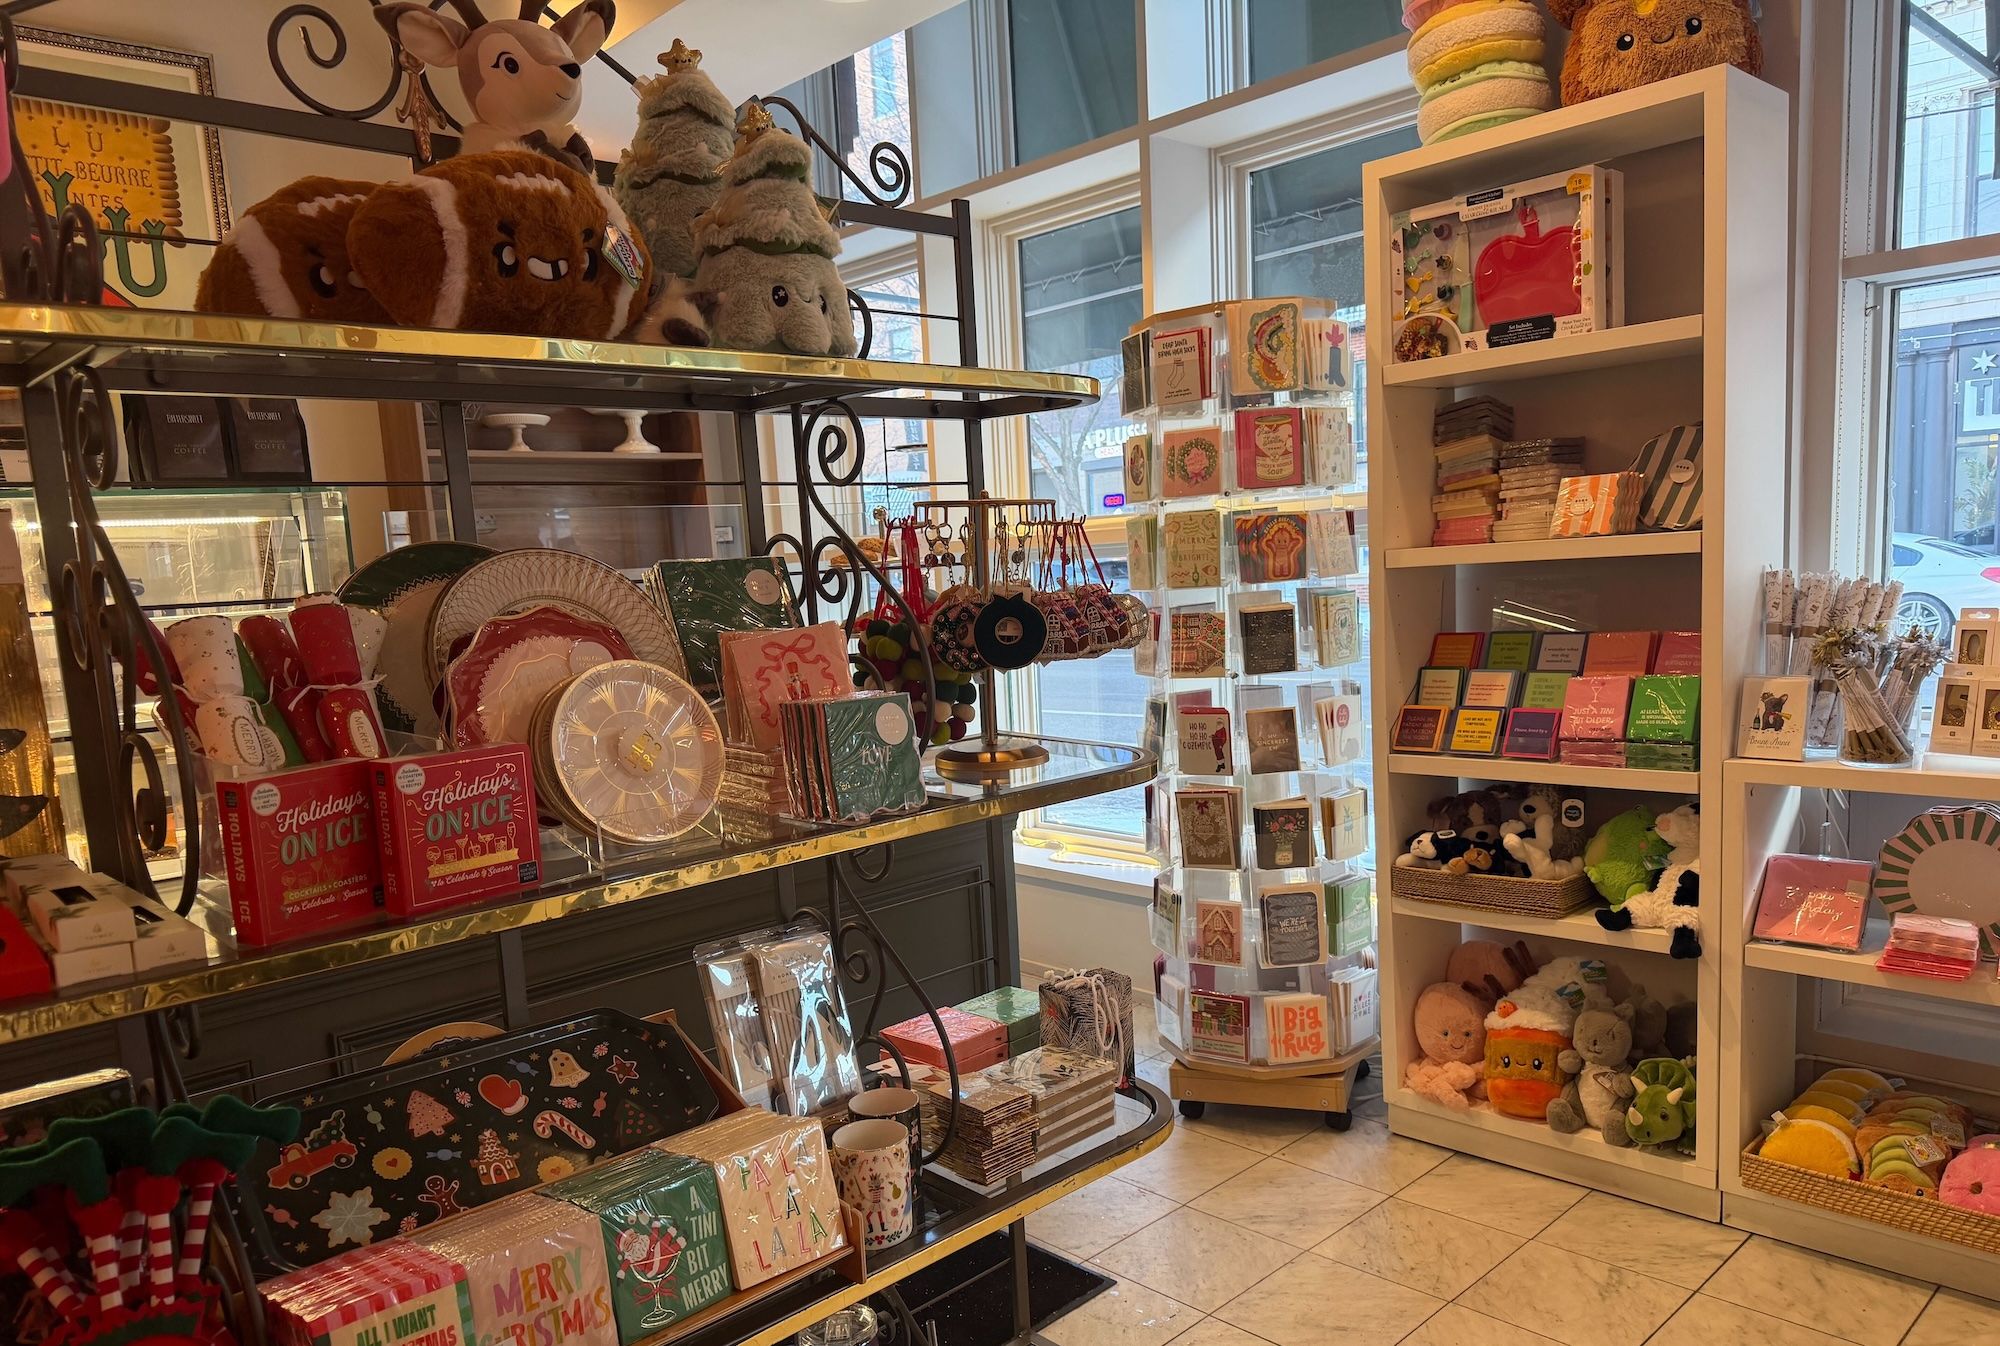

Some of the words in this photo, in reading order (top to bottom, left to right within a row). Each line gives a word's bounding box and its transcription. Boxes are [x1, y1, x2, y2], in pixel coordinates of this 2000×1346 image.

[1189, 722, 1198, 731] HO
[1198, 722, 1207, 731] HO
[1189, 731, 1198, 740] HO
[1199, 731, 1208, 740] HO
[276, 791, 367, 833] Holidays
[422, 773, 513, 812] Holidays
[378, 790, 393, 856] HOLIDAYS
[425, 807, 463, 842] ON
[471, 793, 513, 830] ICE
[280, 827, 318, 865] ON
[326, 812, 369, 852] ICE
[228, 813, 246, 882] HOLIDAYS
[238, 900, 251, 925] ICE
[446, 870, 480, 884] Celebrate
[487, 864, 513, 877] Season
[301, 895, 336, 911] Celebrate
[1283, 1005, 1323, 1032] Big
[689, 1185, 701, 1212] A
[687, 1243, 711, 1276] BIT
[493, 1246, 583, 1318] MERRY
[680, 1262, 730, 1312] MERRY
[356, 1325, 382, 1346] ALL
[392, 1303, 437, 1341] WANT
